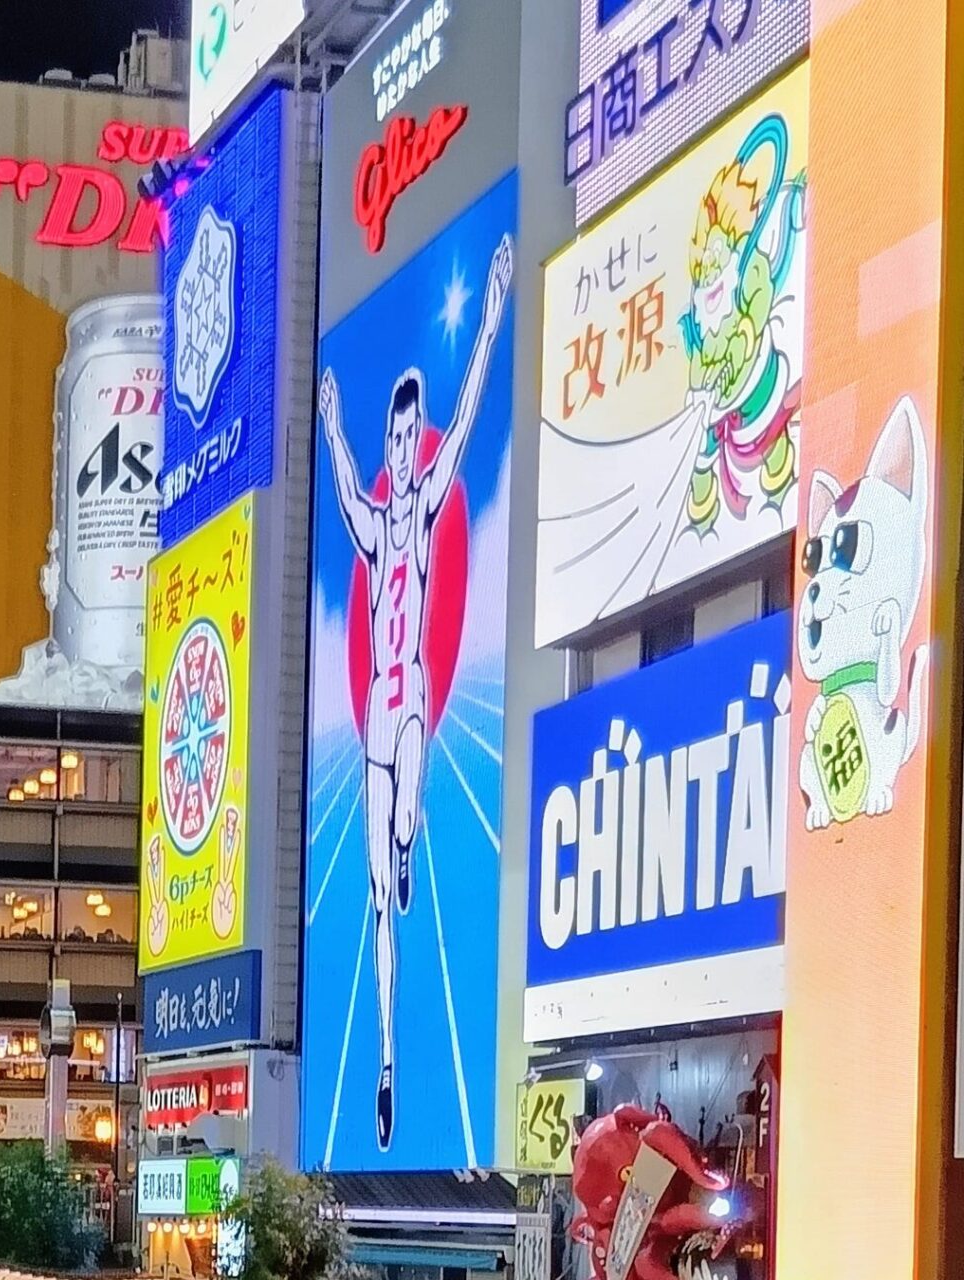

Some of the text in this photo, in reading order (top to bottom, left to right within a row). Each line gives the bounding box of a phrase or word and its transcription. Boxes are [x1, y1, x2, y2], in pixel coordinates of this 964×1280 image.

[564, 0, 757, 187] 日商エス
[353, 105, 468, 253] Glico
[562, 272, 666, 421] 改源
[162, 416, 242, 513] 雪印メグミルク
[385, 551, 409, 711] グリコ
[147, 1084, 198, 1113] LOTTERIA
[759, 1081, 770, 1148] 2F
